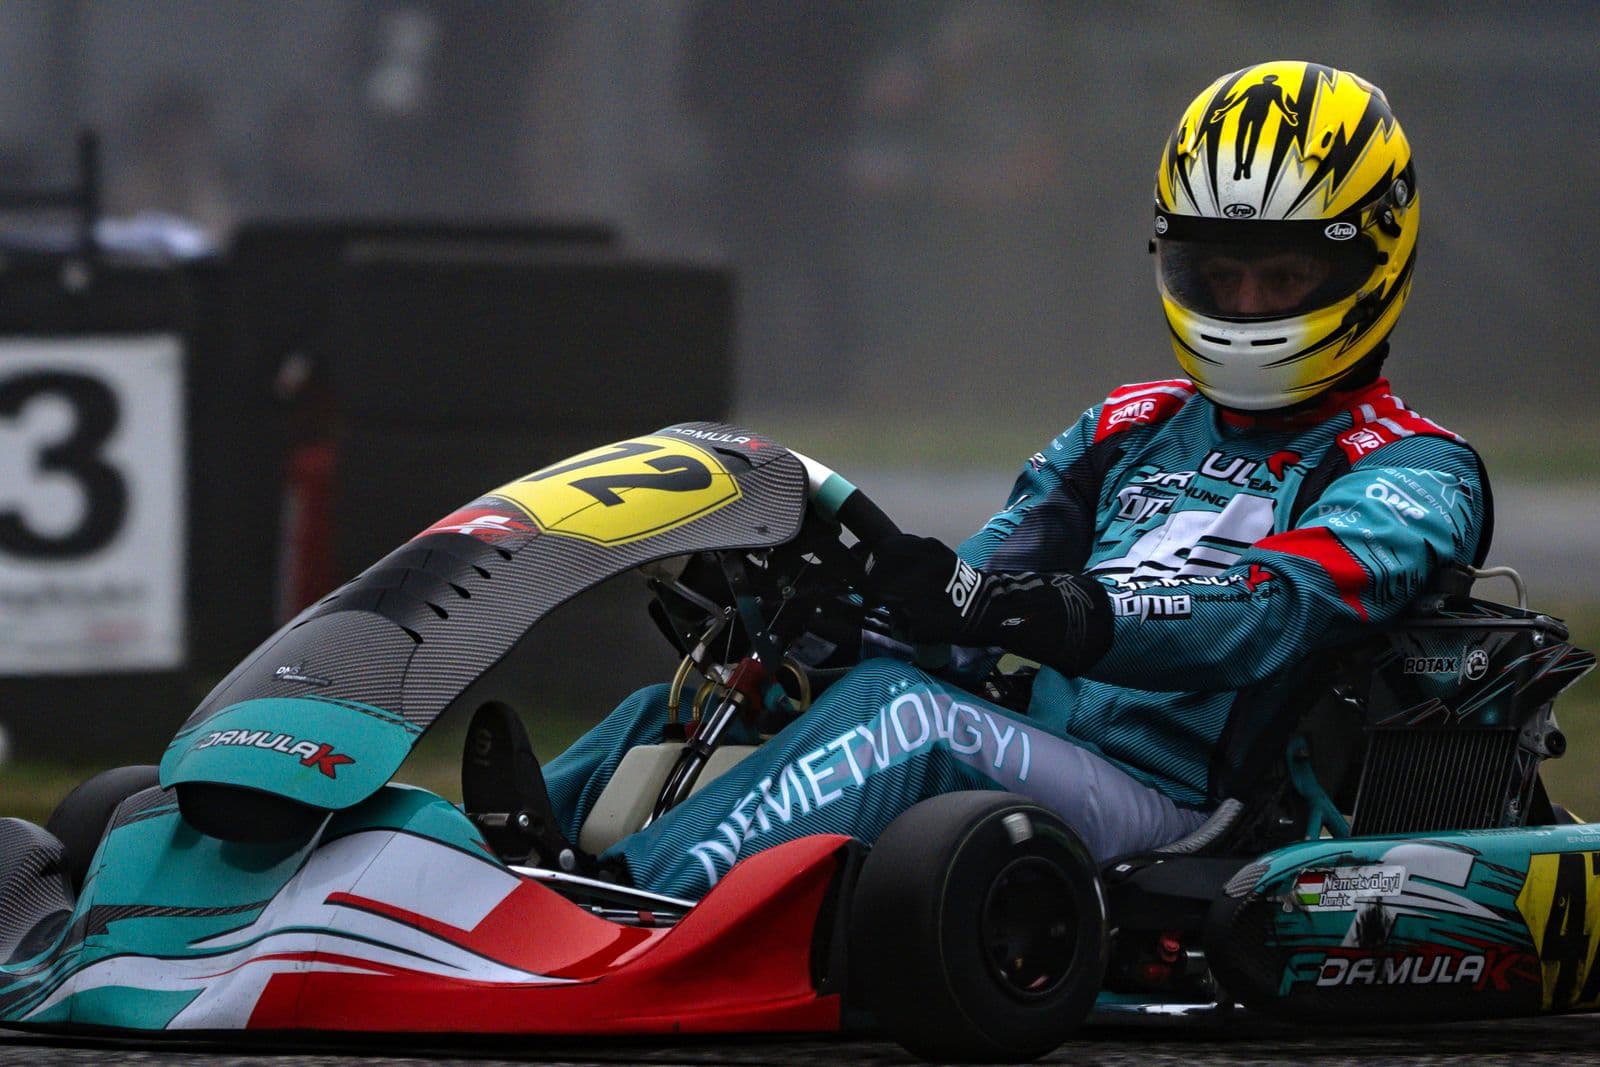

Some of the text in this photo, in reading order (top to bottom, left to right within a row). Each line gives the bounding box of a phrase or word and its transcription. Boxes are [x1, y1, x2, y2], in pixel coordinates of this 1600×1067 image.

[1327, 224, 1355, 237] Arai
[1107, 399, 1157, 430] OMP
[0, 367, 131, 558] 3
[522, 442, 713, 508] 12
[1404, 657, 1459, 674] ROTAX
[193, 729, 356, 779] ORMULAK
